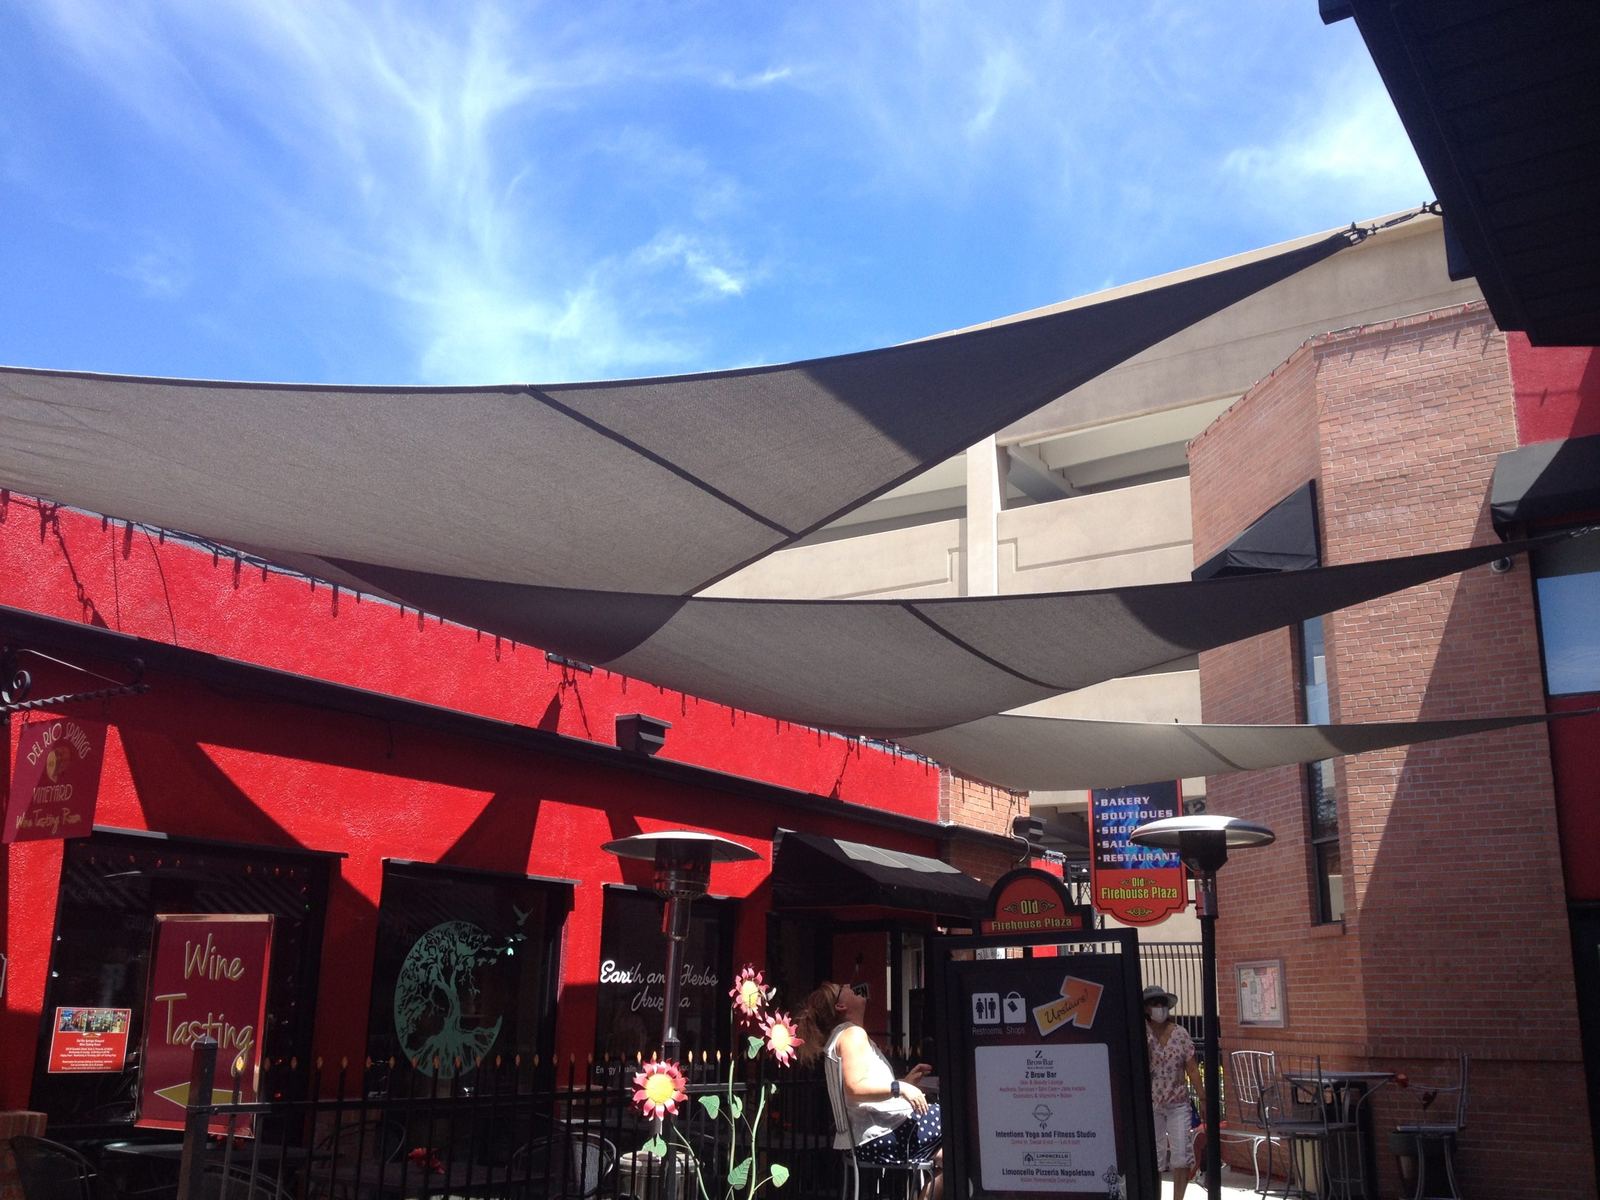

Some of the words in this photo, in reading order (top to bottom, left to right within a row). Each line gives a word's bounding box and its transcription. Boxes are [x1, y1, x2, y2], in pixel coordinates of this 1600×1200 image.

[26, 741, 44, 766] DEL
[42, 722, 62, 748] RIO
[63, 721, 92, 759] SPRINGS
[33, 784, 73, 804] VINEYARD
[1100, 796, 1150, 807] BAKERY
[1101, 809, 1173, 821] BOUTIQUES
[1101, 825, 1139, 835] SHOP
[1103, 852, 1178, 862] RESTAURANT
[1131, 877, 1145, 888] Old
[1101, 887, 1149, 900] Firehouse
[1151, 887, 1179, 899] Plaza
[1020, 900, 1039, 915] Old
[991, 919, 1042, 932] Firehouse
[1044, 917, 1073, 929] Plaza
[184, 932, 245, 981] Wine
[600, 959, 645, 984] Earth
[680, 963, 719, 986] Herbs
[631, 985, 691, 1012] Ariza
[155, 993, 254, 1077] Tasting
[1034, 1050, 1043, 1059] Z
[995, 1130, 1024, 1138] Intentions
[1025, 1130, 1040, 1139] Yoga
[1041, 1130, 1053, 1138] and
[1053, 1130, 1075, 1138] Fitness
[1076, 1130, 1096, 1138] Studio
[1002, 1168, 1034, 1176] Limoncello
[1035, 1168, 1059, 1176] Pizzeria
[1060, 1168, 1095, 1177] Napoletana
